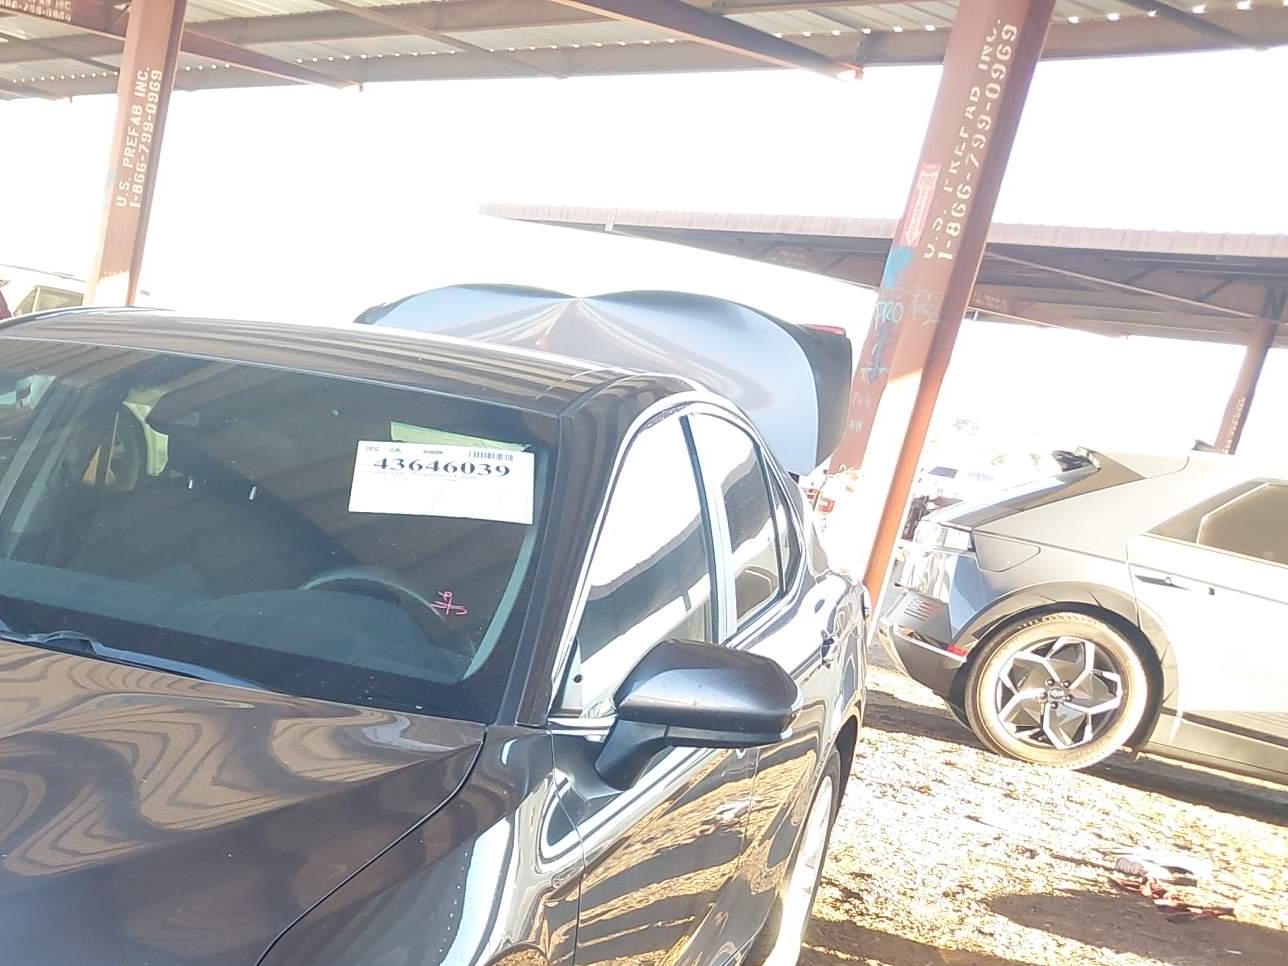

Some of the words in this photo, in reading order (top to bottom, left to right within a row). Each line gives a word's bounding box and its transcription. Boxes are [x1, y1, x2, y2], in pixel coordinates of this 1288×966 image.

[133, 66, 150, 98] INC.
[122, 104, 143, 169] PREFAB
[115, 176, 132, 208] U.S.
[372, 457, 511, 478] 43646039
